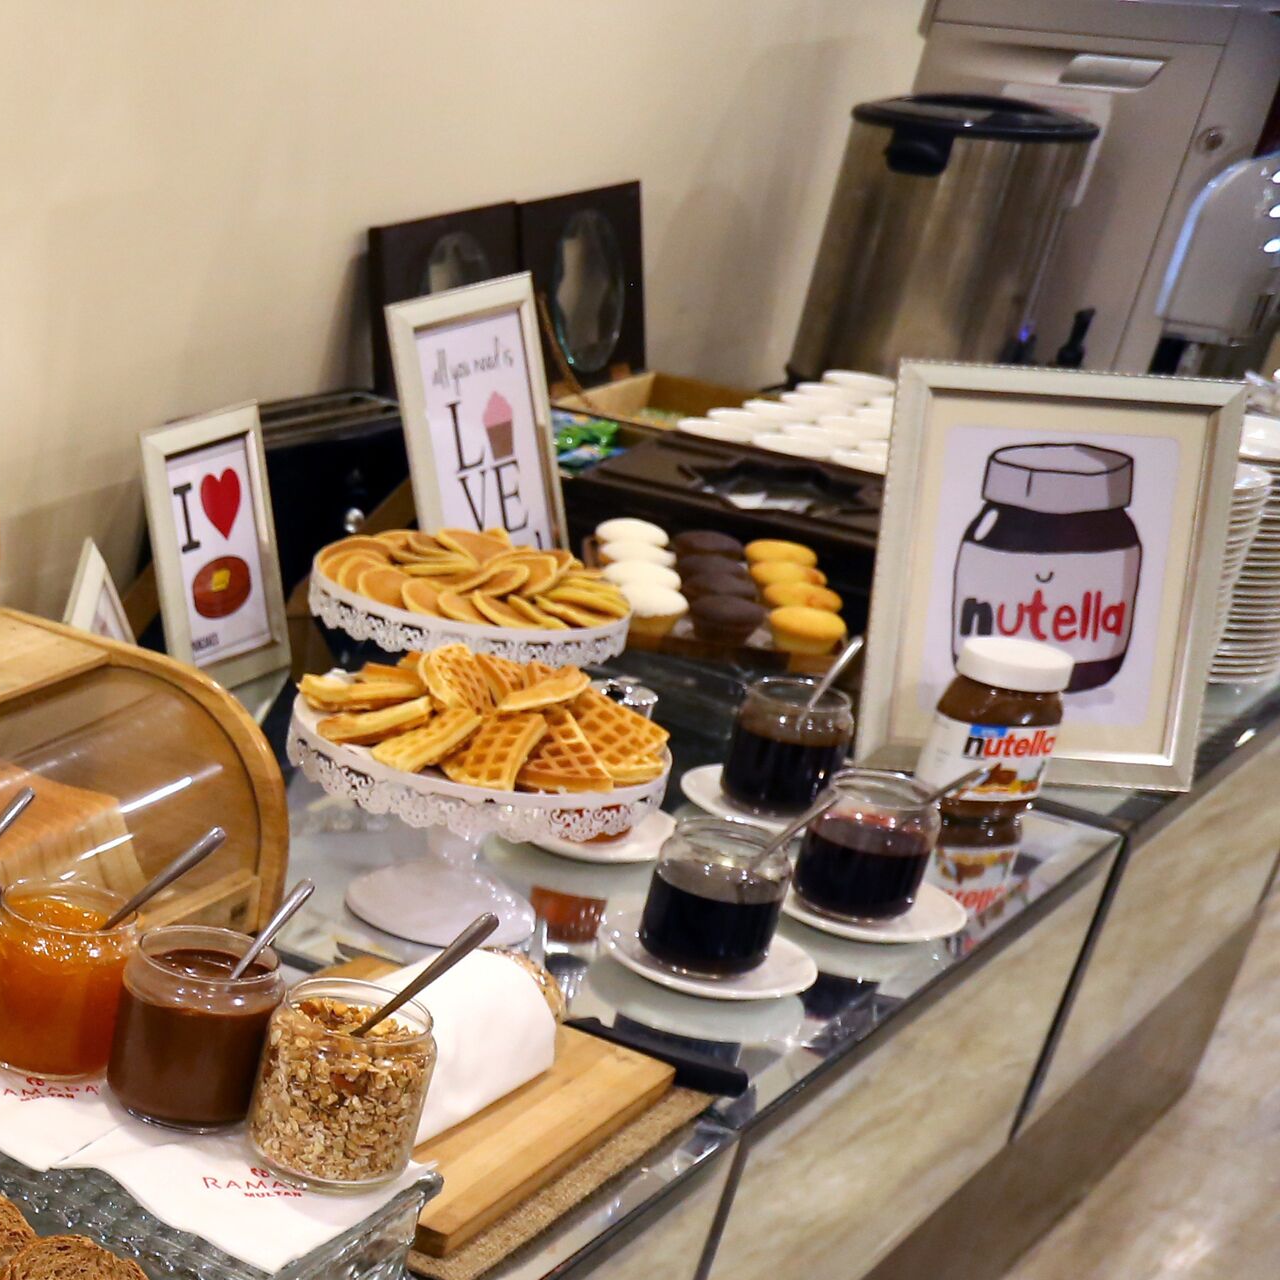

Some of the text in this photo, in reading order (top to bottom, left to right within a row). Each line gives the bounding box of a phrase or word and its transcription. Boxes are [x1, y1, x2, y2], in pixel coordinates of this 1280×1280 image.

[433, 348, 450, 389] all
[451, 361, 471, 396] you
[173, 482, 200, 554] I
[960, 590, 1126, 641] nutella
[963, 730, 1056, 759] nutella
